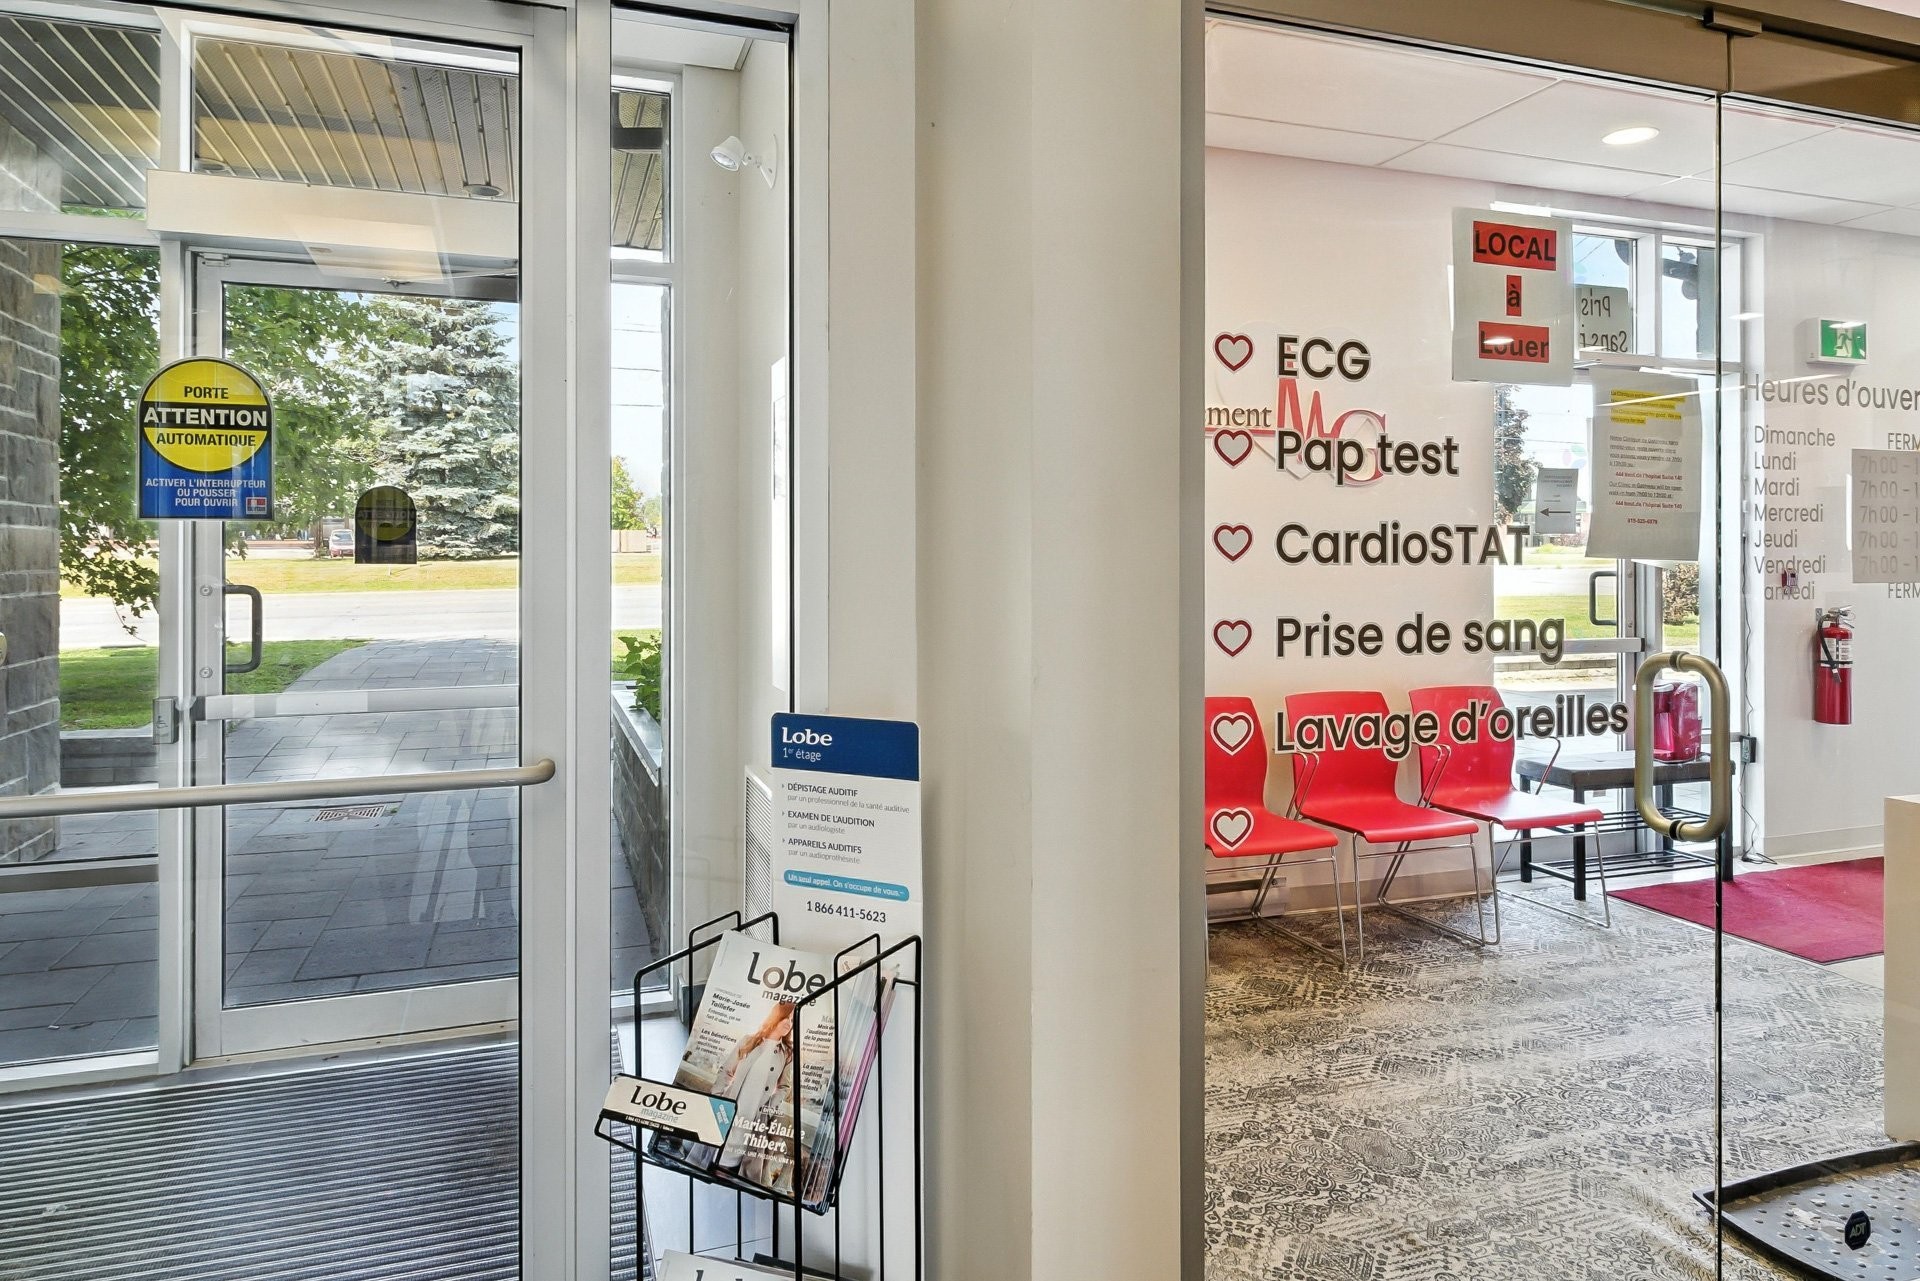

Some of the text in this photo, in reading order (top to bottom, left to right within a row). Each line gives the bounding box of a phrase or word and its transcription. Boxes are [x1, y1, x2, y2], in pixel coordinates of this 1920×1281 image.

[1475, 230, 1556, 262] LOCAL
[1508, 284, 1520, 307] à
[1480, 330, 1549, 358] Louer
[1277, 336, 1371, 381] ECG
[184, 386, 229, 399] PORTE
[143, 406, 267, 427] ATTENTION
[1206, 406, 1272, 427] ment
[156, 433, 256, 447] AUTOMATIQUE
[1754, 425, 1836, 447] Dimanche
[1277, 430, 1459, 486] Pap test
[1755, 451, 1796, 471] Lundi
[145, 478, 266, 488] ACTIVER L'INTERRUPTEUR
[177, 488, 236, 497] OU POUSSER
[1755, 477, 1800, 496] Mardi
[175, 498, 238, 507] POUR OUVRIR
[1755, 503, 1824, 522] Mercredi
[1276, 522, 1530, 565] CardioSTAT
[1755, 529, 1798, 548] Jeudi
[1754, 555, 1826, 574] Vendredi
[1764, 581, 1815, 601] amedi
[1277, 613, 1565, 664] Prise de sang
[1277, 695, 1629, 758] Lavage d'oreilles
[782, 727, 833, 746] Lobe
[796, 749, 822, 762] étage
[787, 782, 858, 797] DÉPISTAGE AUDITIF
[808, 797, 849, 807] professionnel
[866, 803, 883, 811] santé
[884, 804, 910, 814] auditive
[787, 810, 875, 828] EXAMEN DE L'AUDITION
[808, 824, 846, 835] audiologiste
[788, 838, 862, 854] APPAREILS AUDITIFS
[788, 873, 798, 882] Un
[832, 880, 843, 888] On
[873, 886, 882, 894] de
[806, 901, 887, 923] 1 866 411-5623
[748, 951, 826, 995] Lobe
[712, 993, 751, 1009] Marie-Josée
[630, 1085, 687, 1115] Lobe
[640, 1108, 679, 1123] magazine
[1850, 1222, 1867, 1238] ADT
